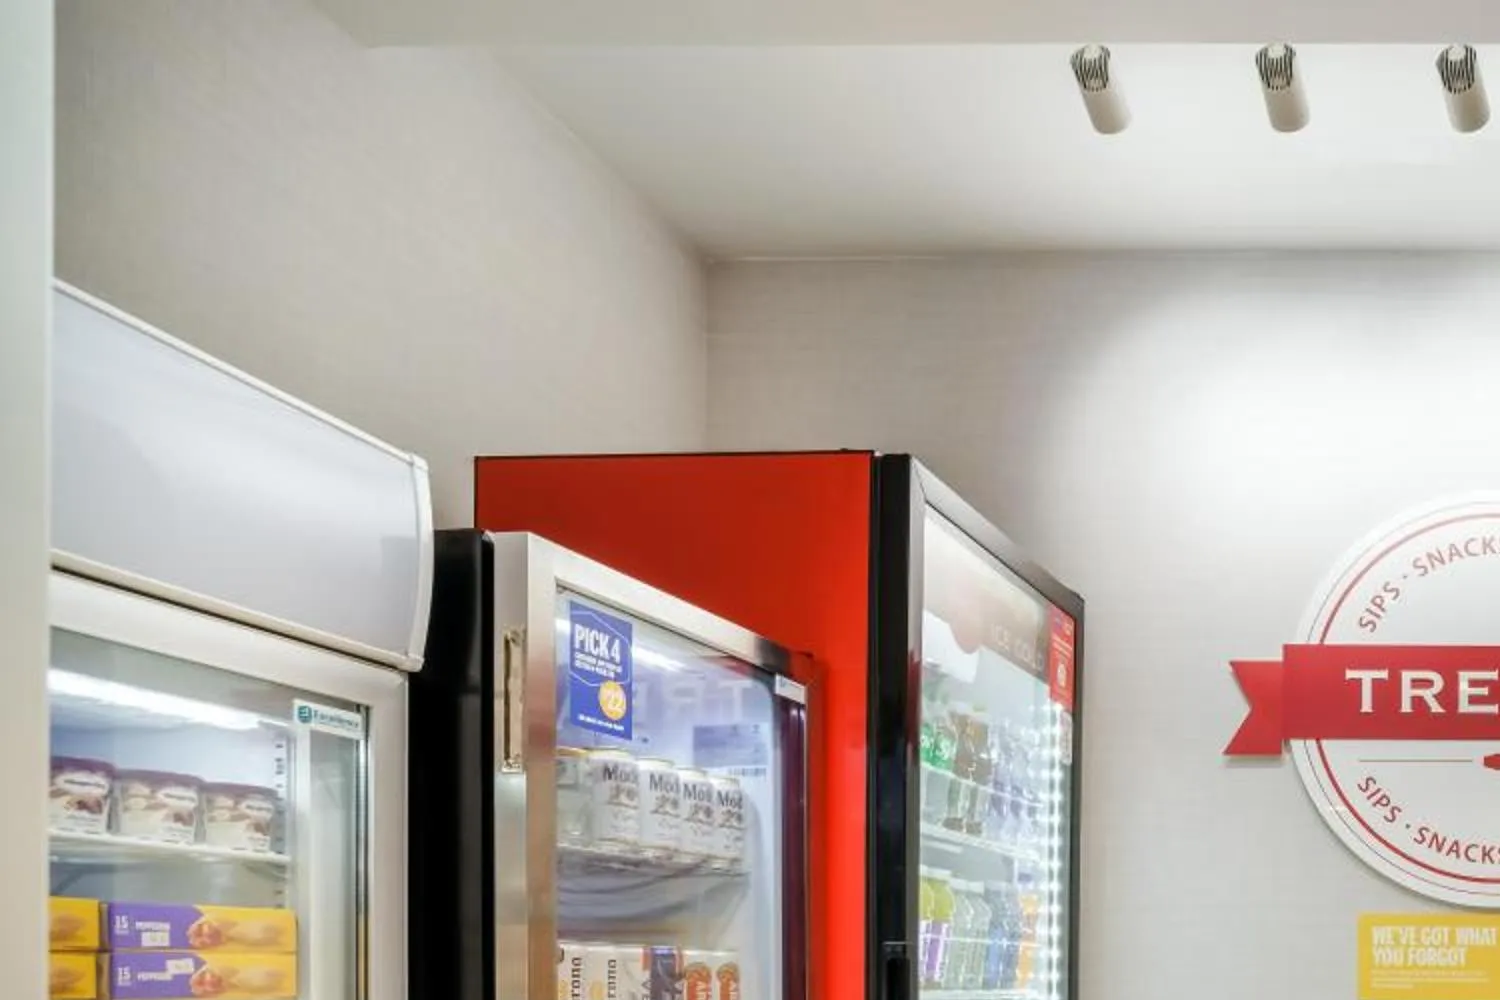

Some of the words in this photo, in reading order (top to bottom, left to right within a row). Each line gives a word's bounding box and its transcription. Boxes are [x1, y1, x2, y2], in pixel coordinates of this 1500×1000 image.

[1357, 582, 1401, 634] SIPS
[574, 623, 610, 660] PICK
[611, 638, 620, 664] 4
[1357, 775, 1403, 824] SIPS
[1371, 925, 1420, 946] WE'VE
[1421, 926, 1450, 946] GOT
[1456, 926, 1498, 946] WHAT
[1372, 947, 1403, 967] YOU
[1407, 947, 1467, 967] FORGOT
